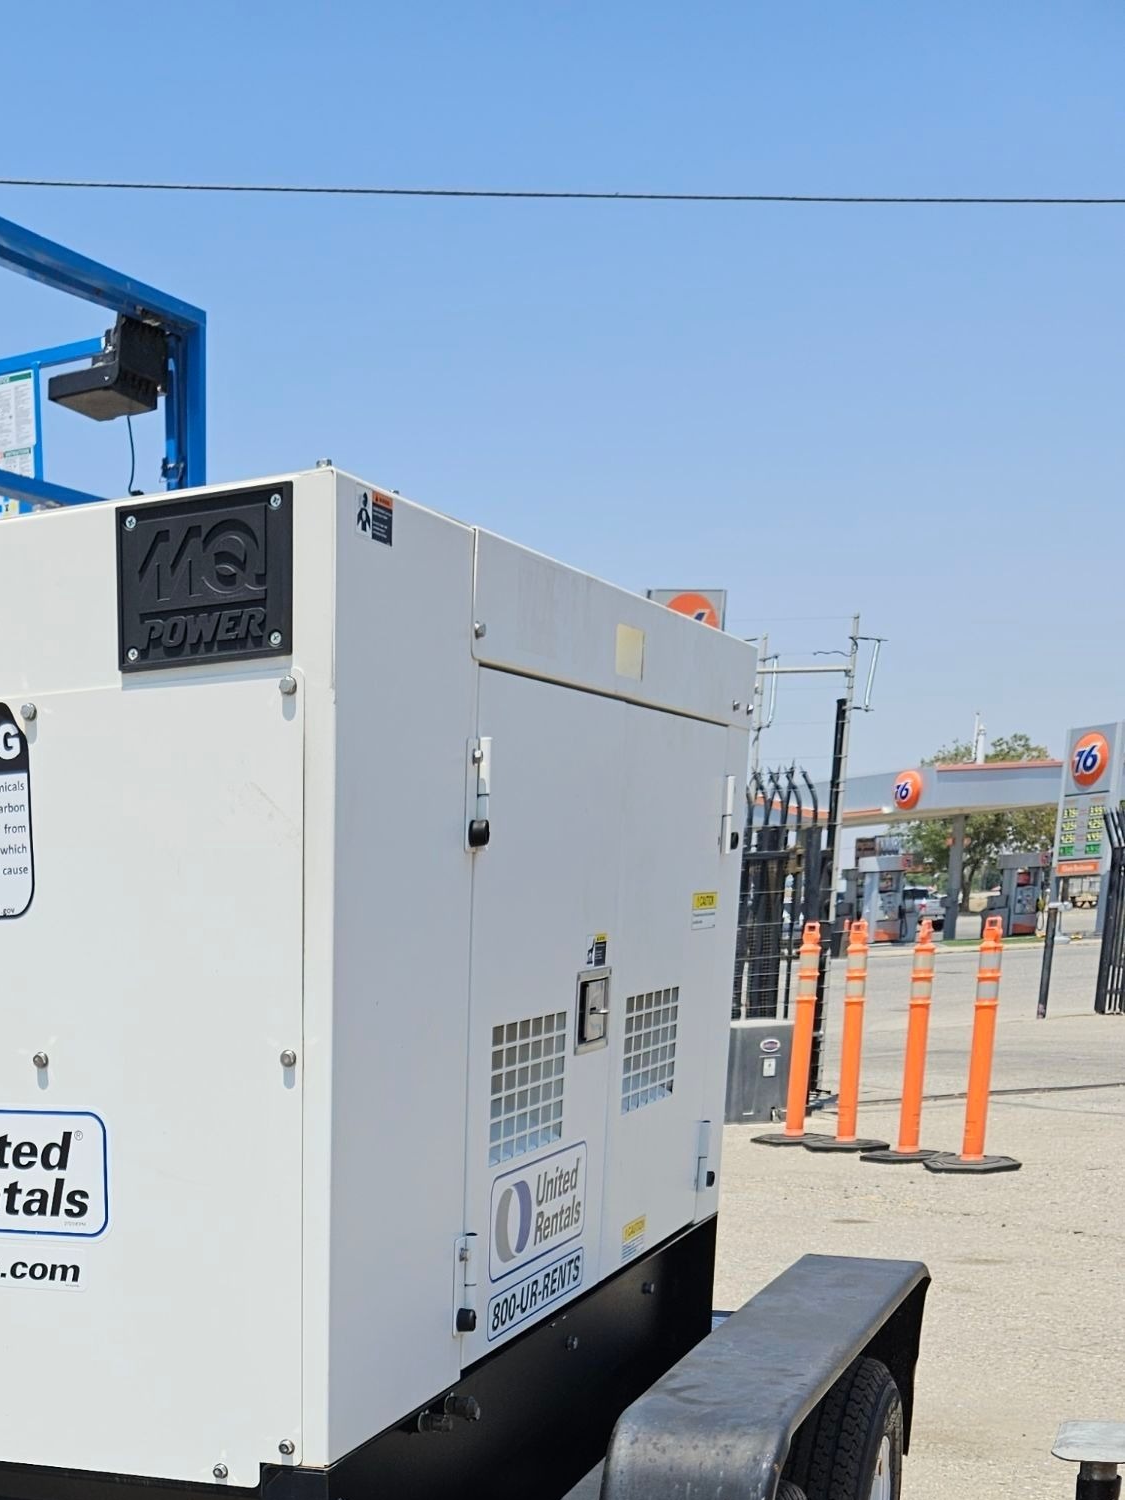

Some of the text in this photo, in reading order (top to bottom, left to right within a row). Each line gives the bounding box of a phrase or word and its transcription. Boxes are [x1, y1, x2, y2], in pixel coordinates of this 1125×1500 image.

[139, 519, 267, 602] MQ
[141, 607, 267, 648] POWER
[1075, 745, 1097, 774] 76
[4, 824, 26, 834] from
[0, 844, 27, 856] which
[3, 865, 28, 875] cause
[535, 1157, 579, 1207] United
[534, 1195, 581, 1246] Rentals
[492, 1254, 580, 1332] 800-UR-RENTS
